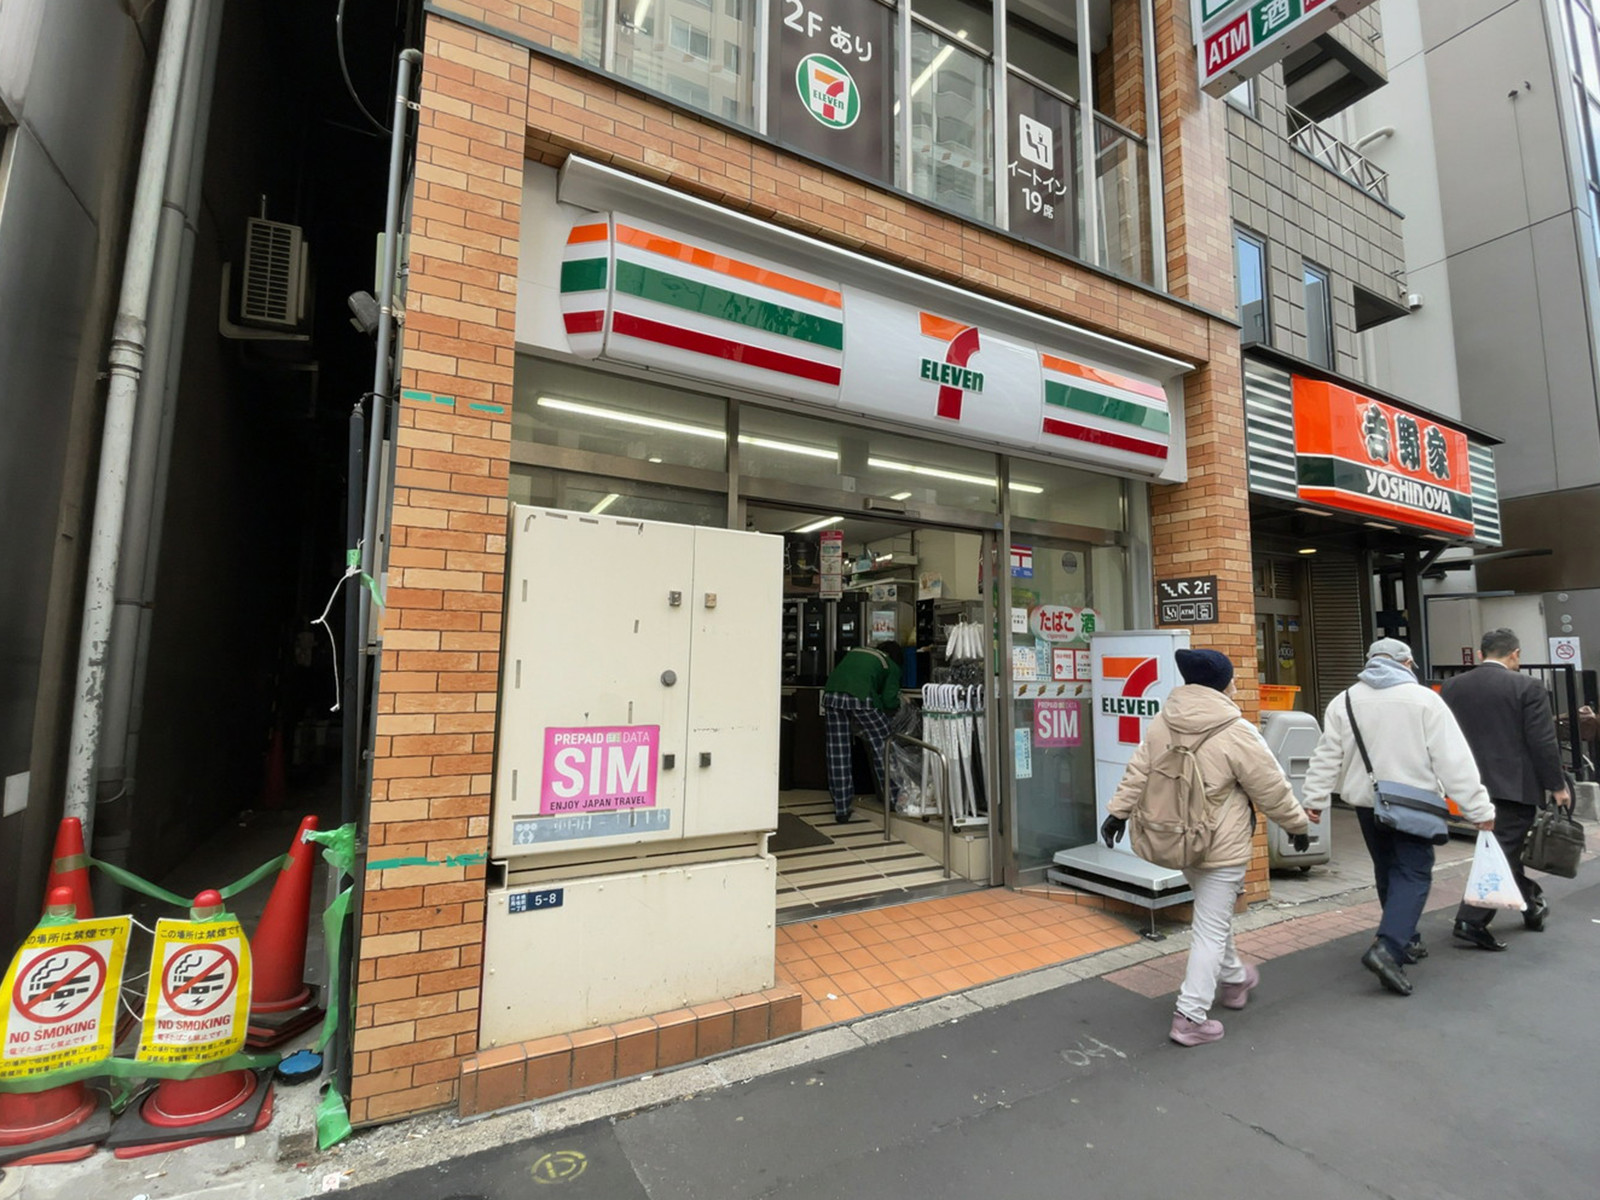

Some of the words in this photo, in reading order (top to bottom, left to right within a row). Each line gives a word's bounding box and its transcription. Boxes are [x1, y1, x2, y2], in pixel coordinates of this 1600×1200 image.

[1260, 0, 1290, 36] 酒
[1208, 21, 1247, 70] ATM
[1007, 160, 1067, 195] イートイン
[1362, 403, 1450, 481] 吉野家
[1366, 469, 1452, 514] YOSHINOYA
[1193, 580, 1212, 595] 2F
[1040, 610, 1074, 632] たばこ
[1080, 612, 1095, 634] 酒
[1038, 709, 1079, 739] SIM
[554, 733, 604, 746] PREPAID
[622, 731, 650, 744] DATA
[552, 745, 650, 797] SIM
[550, 801, 580, 812] ENJOY
[582, 798, 612, 809] JAPAN
[614, 796, 646, 806] TRAVEL
[534, 892, 557, 906] 5-8
[9, 1031, 30, 1044] NO
[33, 1018, 97, 1041] SMOKING
[157, 1019, 173, 1030] NO
[175, 1014, 231, 1031] SMOKING
